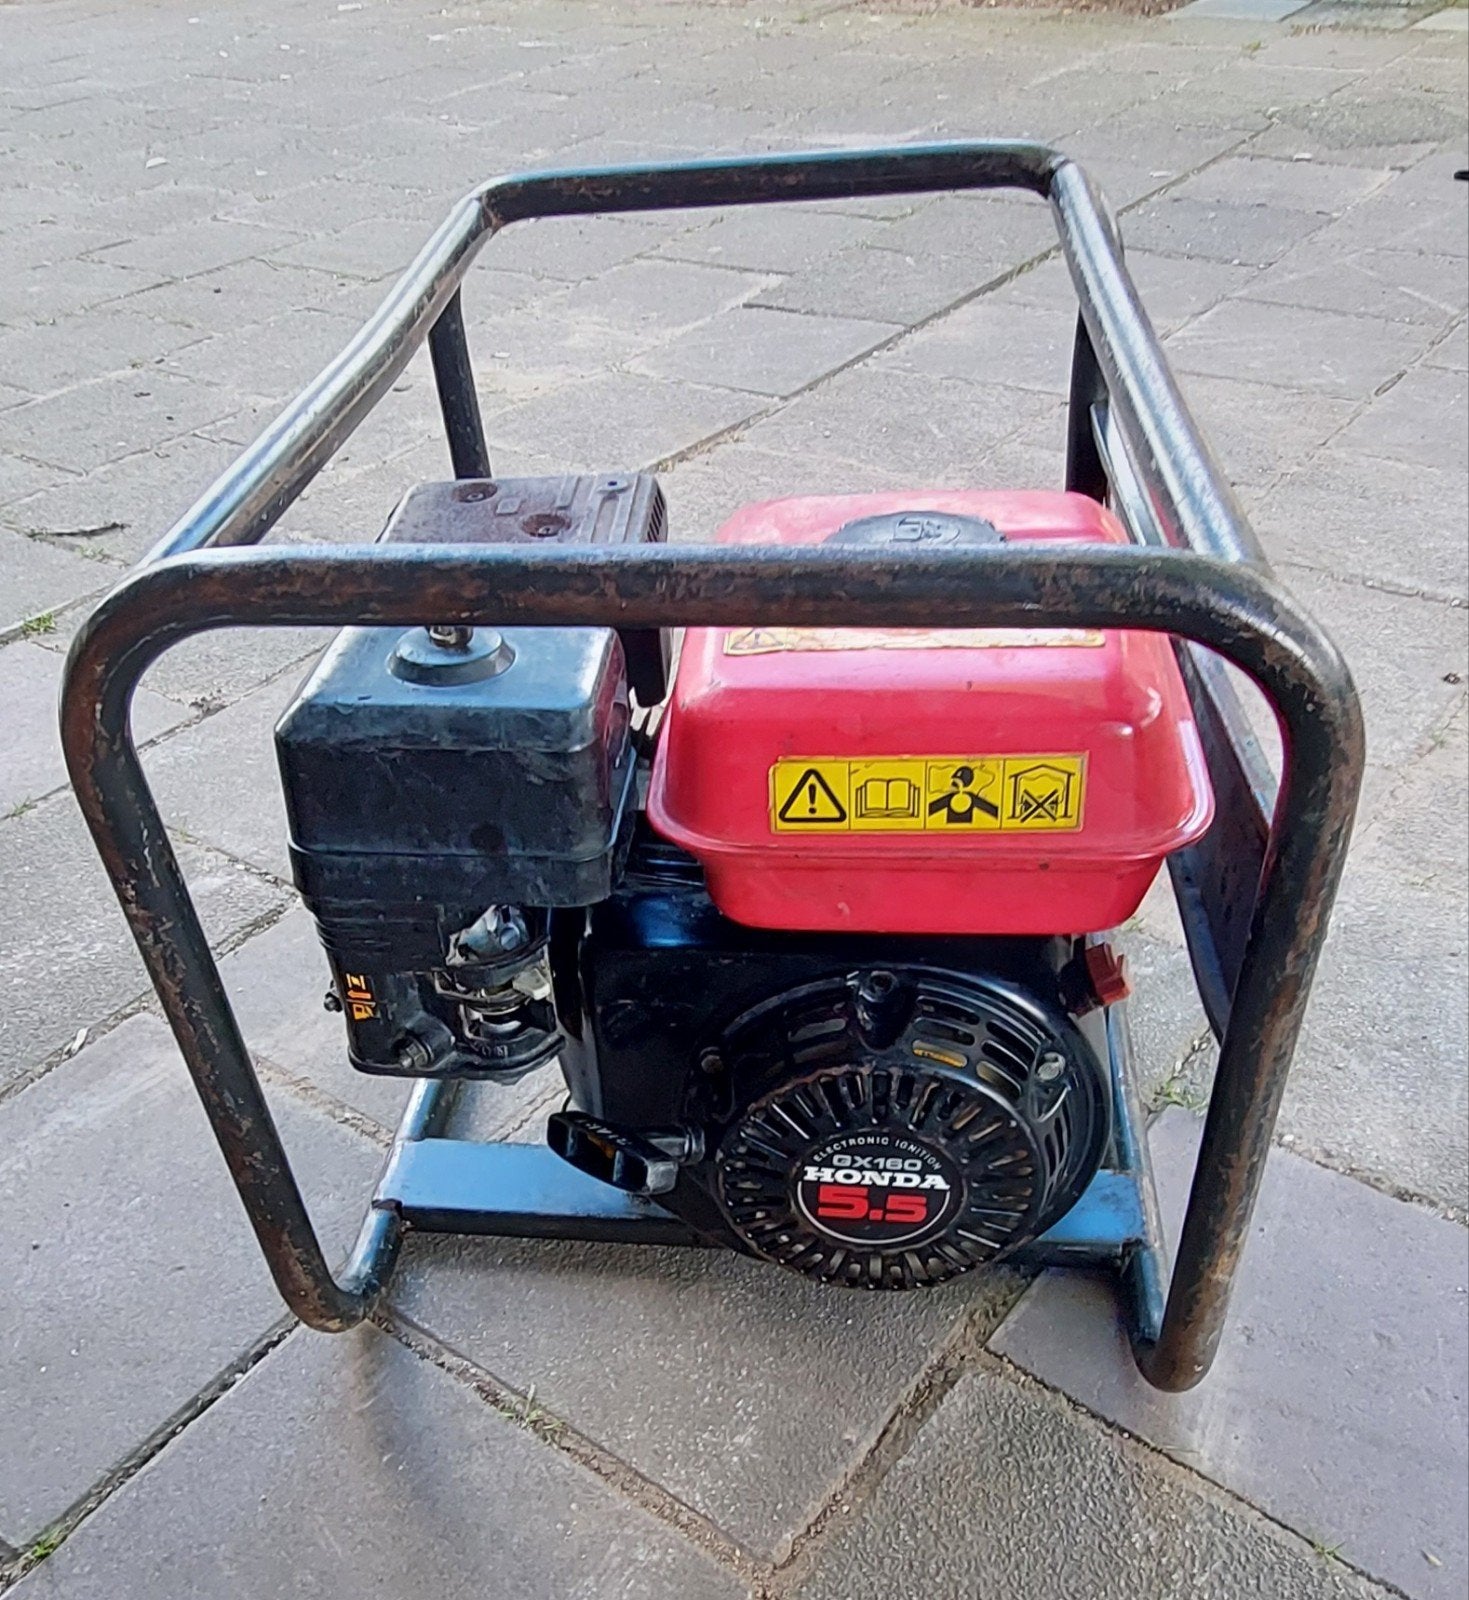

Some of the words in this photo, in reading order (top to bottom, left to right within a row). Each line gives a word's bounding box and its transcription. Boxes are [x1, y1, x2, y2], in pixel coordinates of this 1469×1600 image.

[813, 1136, 890, 1162] ELECTRONIC
[895, 1139, 942, 1171] IGNITION
[832, 1154, 922, 1172] GX160
[803, 1166, 951, 1190] HONDA
[818, 1185, 928, 1223] 5.5
